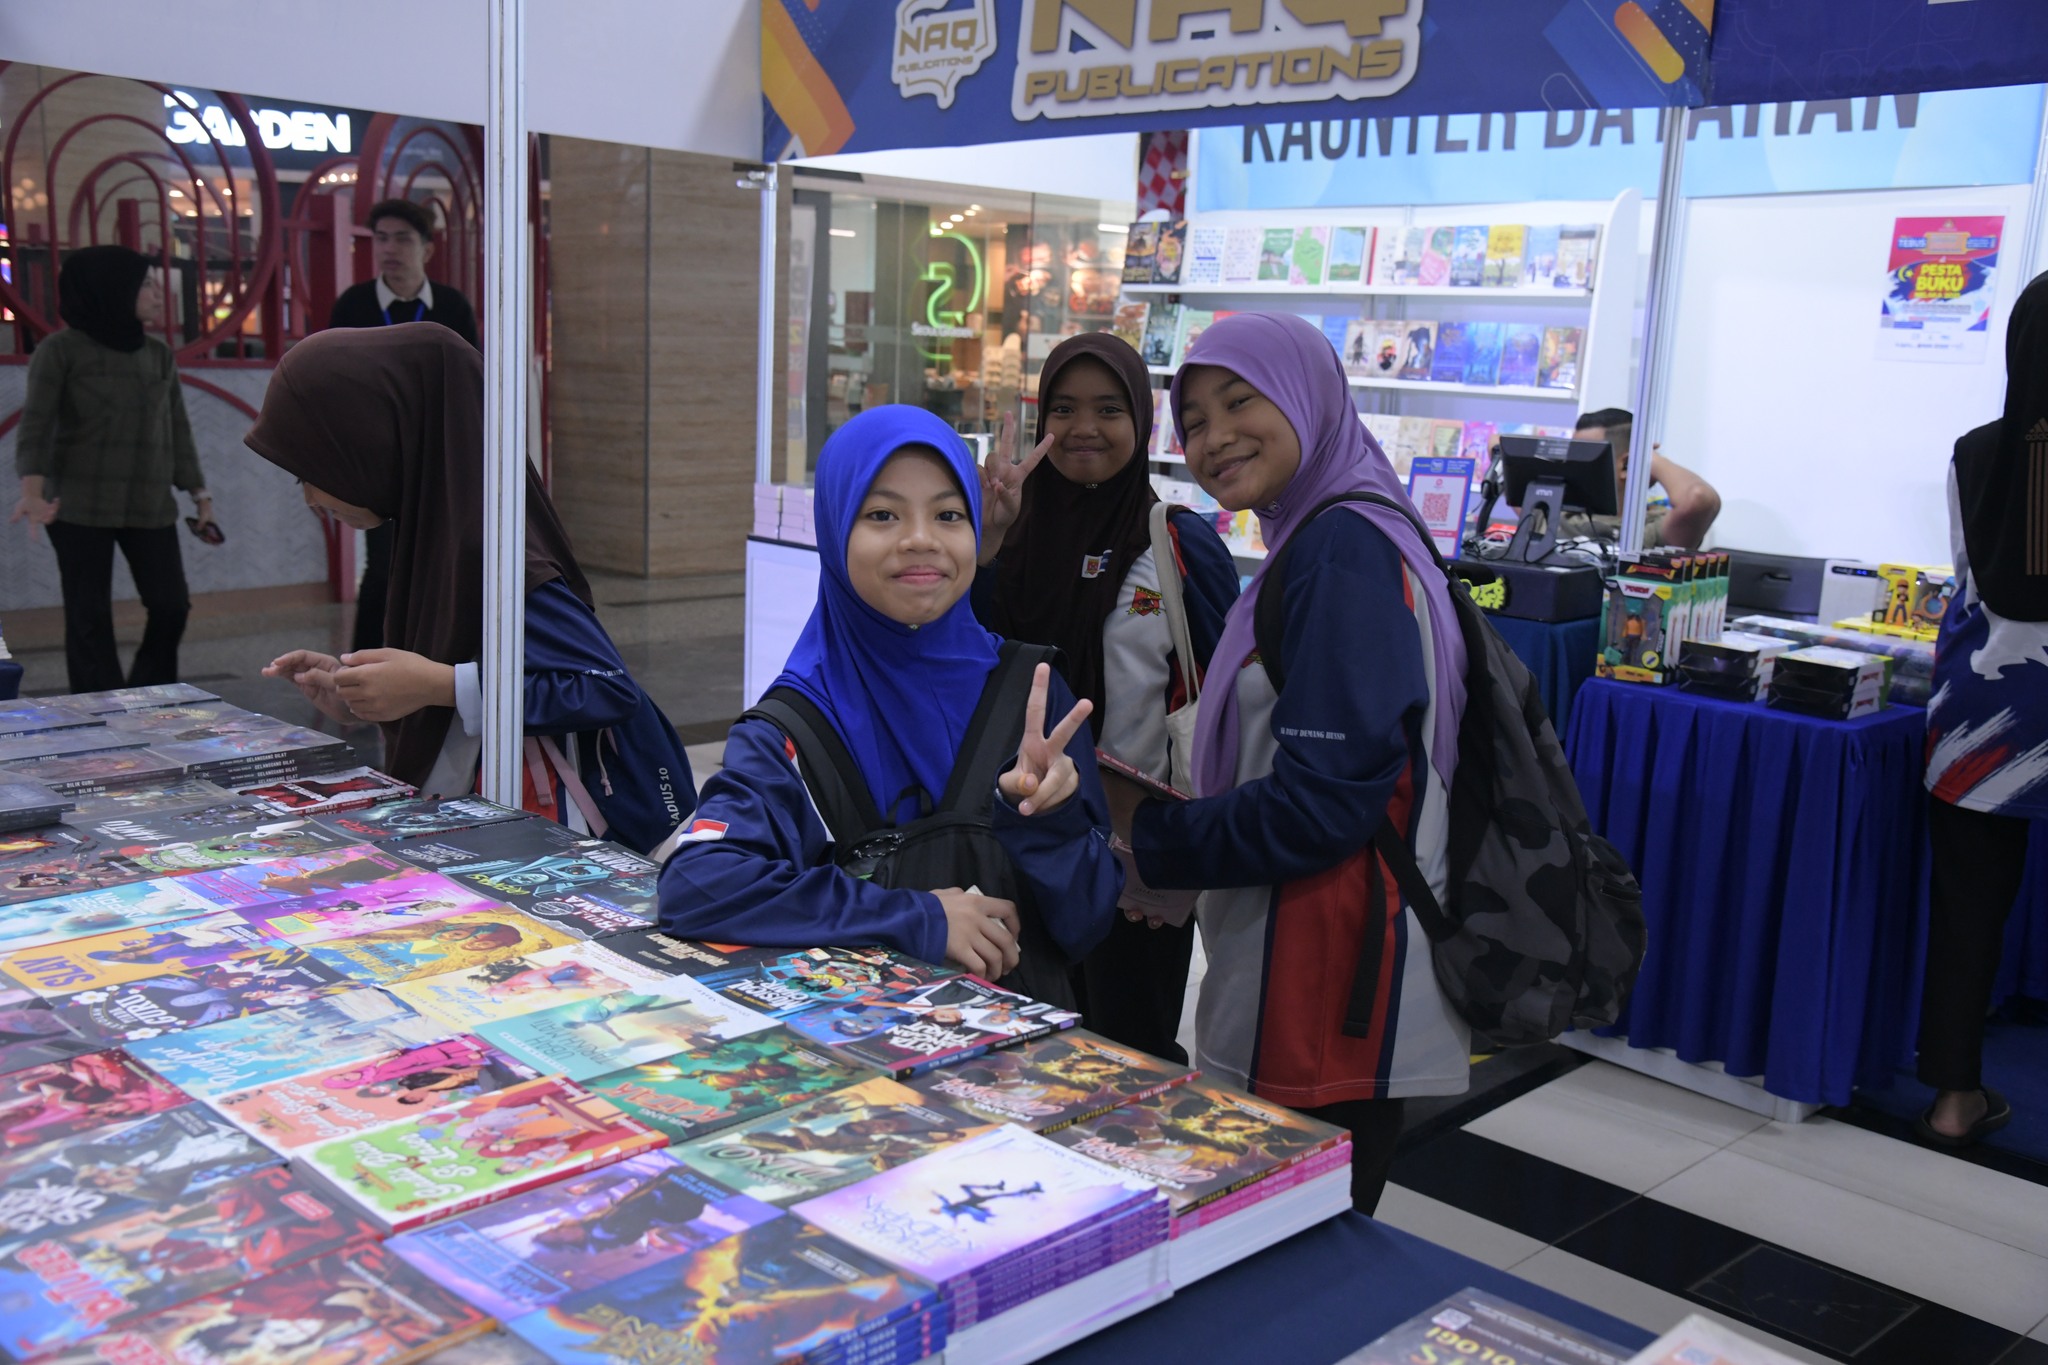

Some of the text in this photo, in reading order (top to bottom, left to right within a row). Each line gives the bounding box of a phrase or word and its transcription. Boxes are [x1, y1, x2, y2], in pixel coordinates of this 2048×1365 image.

[899, 19, 977, 56] NAQ
[897, 56, 974, 73] PUBLICATIONS
[1025, 40, 1403, 105] PUBLICATIONS
[1915, 276, 1964, 292] BUKU
[1920, 264, 1963, 277] PESTA
[14, 956, 97, 988] SLAY
[727, 978, 798, 1011] MUSICAL
[530, 1034, 578, 1061] UBAH
